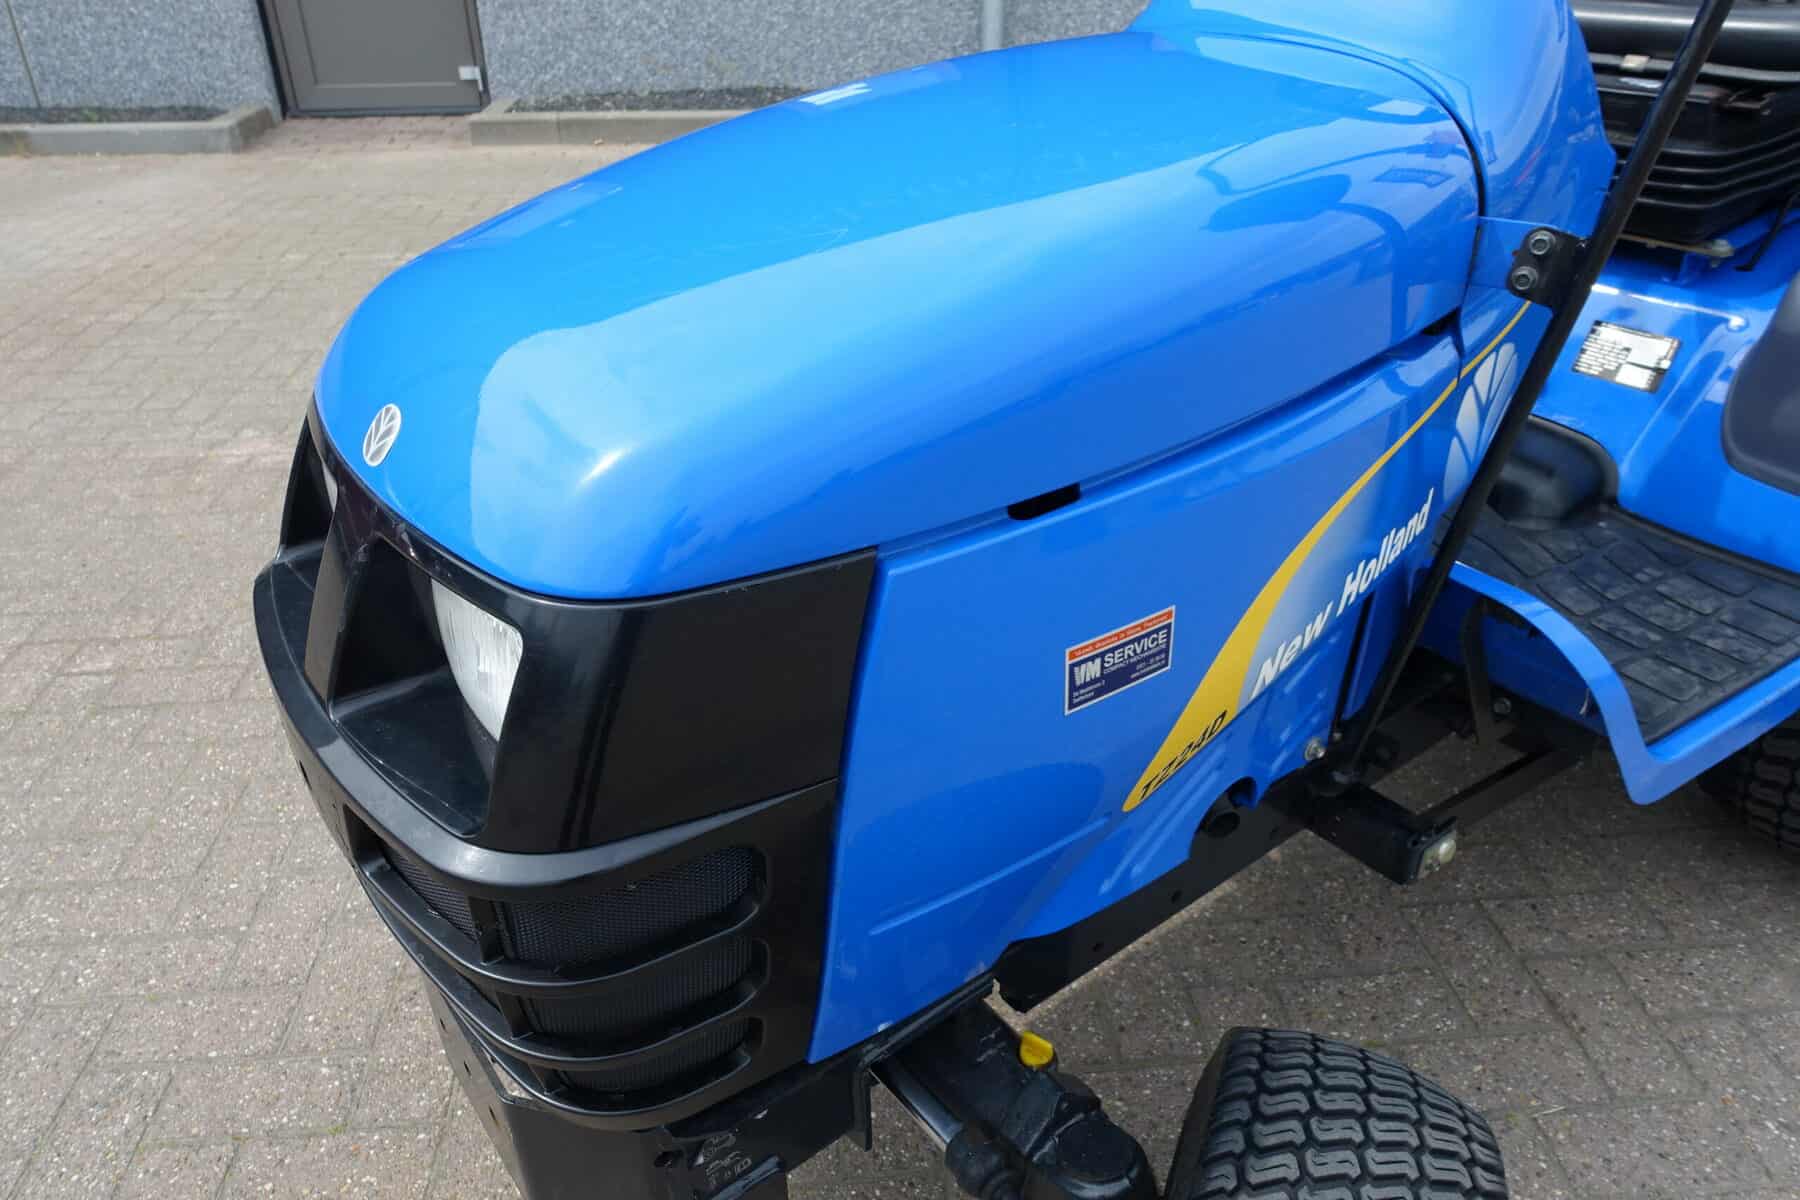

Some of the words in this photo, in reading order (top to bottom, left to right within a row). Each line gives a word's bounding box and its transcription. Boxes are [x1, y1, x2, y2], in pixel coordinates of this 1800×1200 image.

[1104, 629, 1168, 667] SERVICE
[1250, 600, 1334, 700] New
[1337, 487, 1435, 618] Holland
